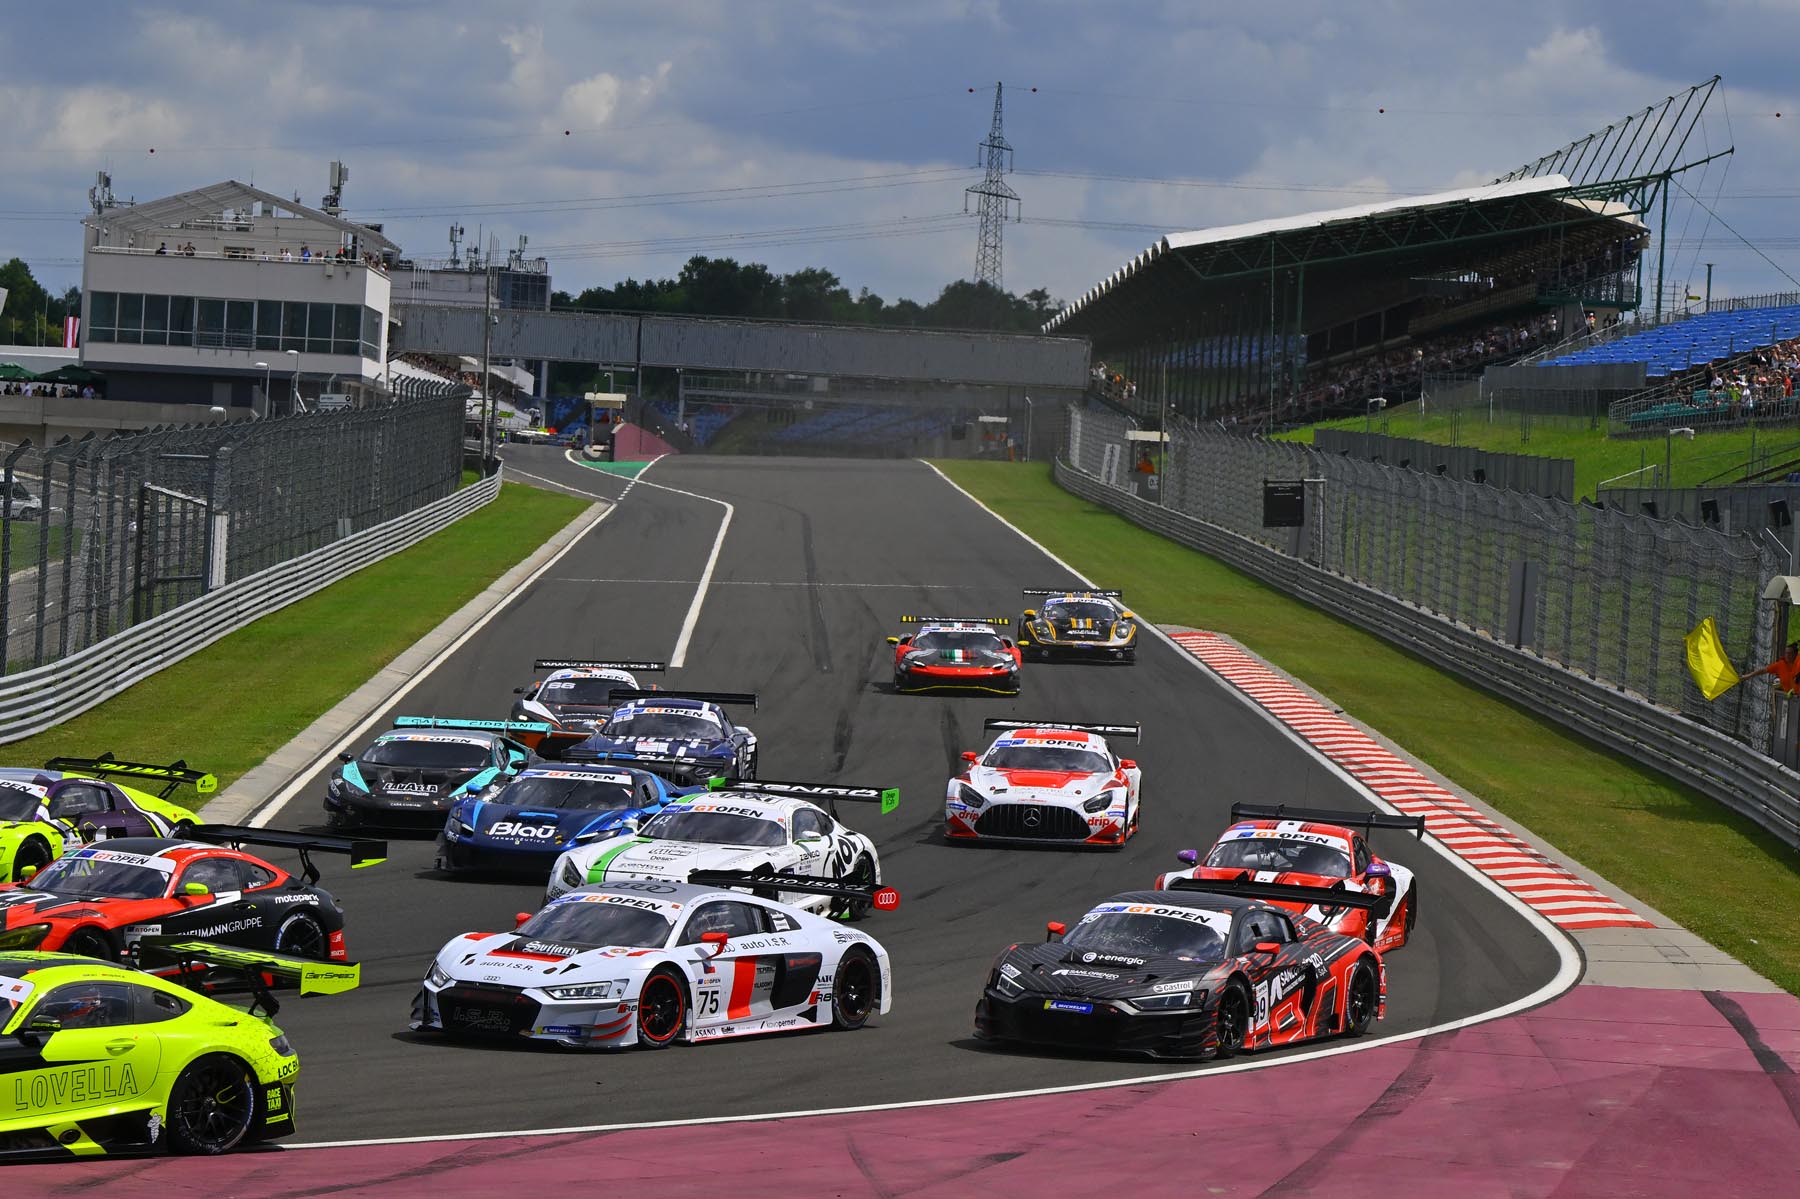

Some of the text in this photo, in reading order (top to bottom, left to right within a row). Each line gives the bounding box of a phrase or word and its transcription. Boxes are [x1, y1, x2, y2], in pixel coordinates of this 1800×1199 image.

[382, 782, 438, 793] LAVAZZA
[958, 809, 979, 823] drip
[1087, 816, 1110, 828] drip
[274, 893, 320, 905] motopark
[740, 940, 765, 950] auto
[1068, 969, 1120, 979] SANLORENZO
[1162, 980, 1193, 992] Castrol
[698, 990, 720, 1015] 75
[15, 1062, 139, 1112] LOVELLA
